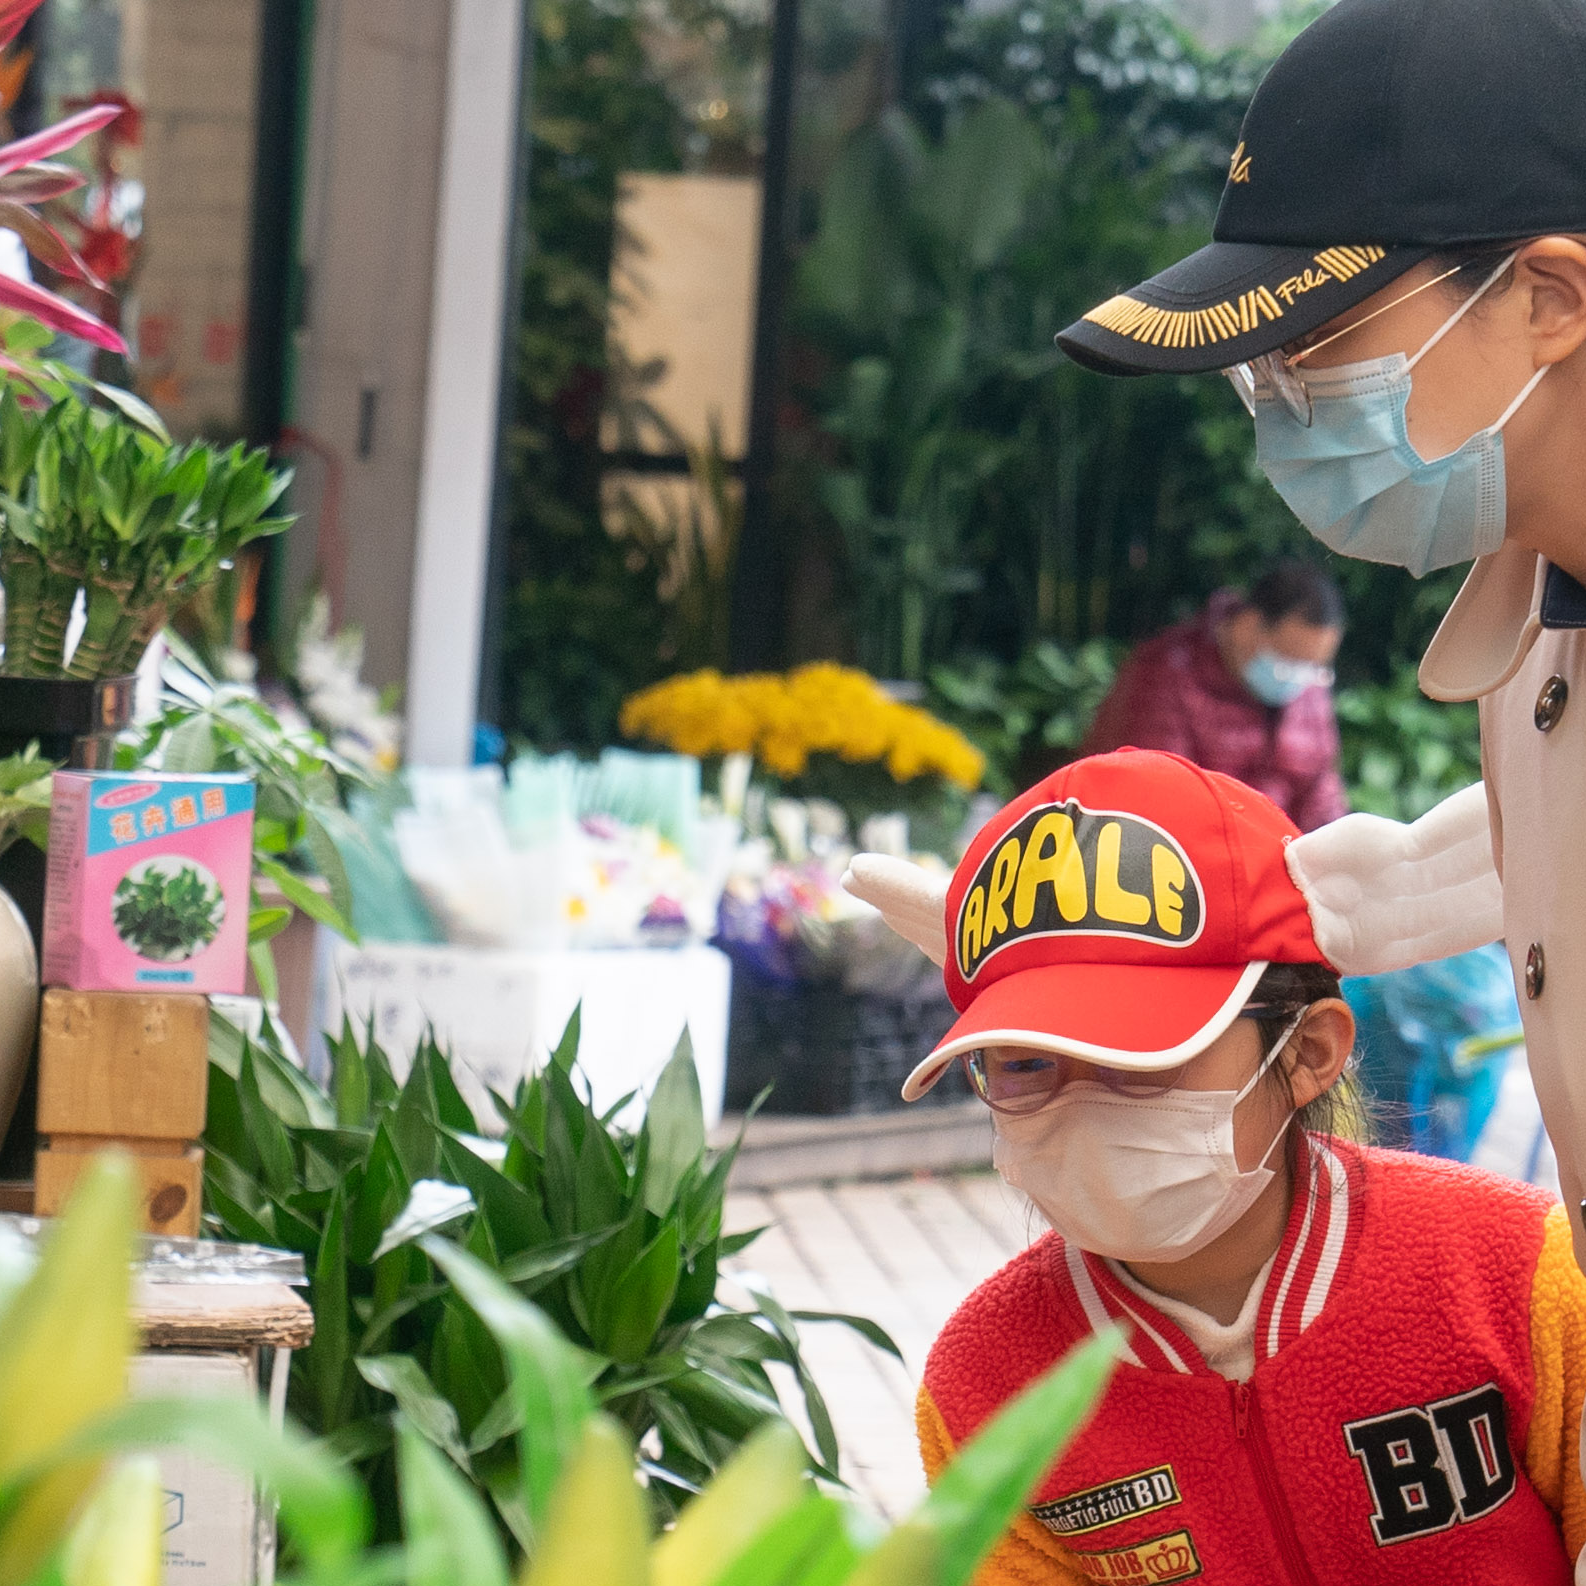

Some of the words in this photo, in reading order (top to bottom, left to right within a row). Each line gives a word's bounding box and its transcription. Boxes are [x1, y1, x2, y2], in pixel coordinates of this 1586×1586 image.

[1275, 268, 1332, 305] Fila
[963, 812, 1186, 973] ARALE
[1342, 1377, 1517, 1547] BD
[1044, 1507, 1099, 1531] ERGETIC
[1100, 1494, 1135, 1520] FULL
[1133, 1473, 1173, 1508] BD
[1105, 1551, 1144, 1577] JOB
